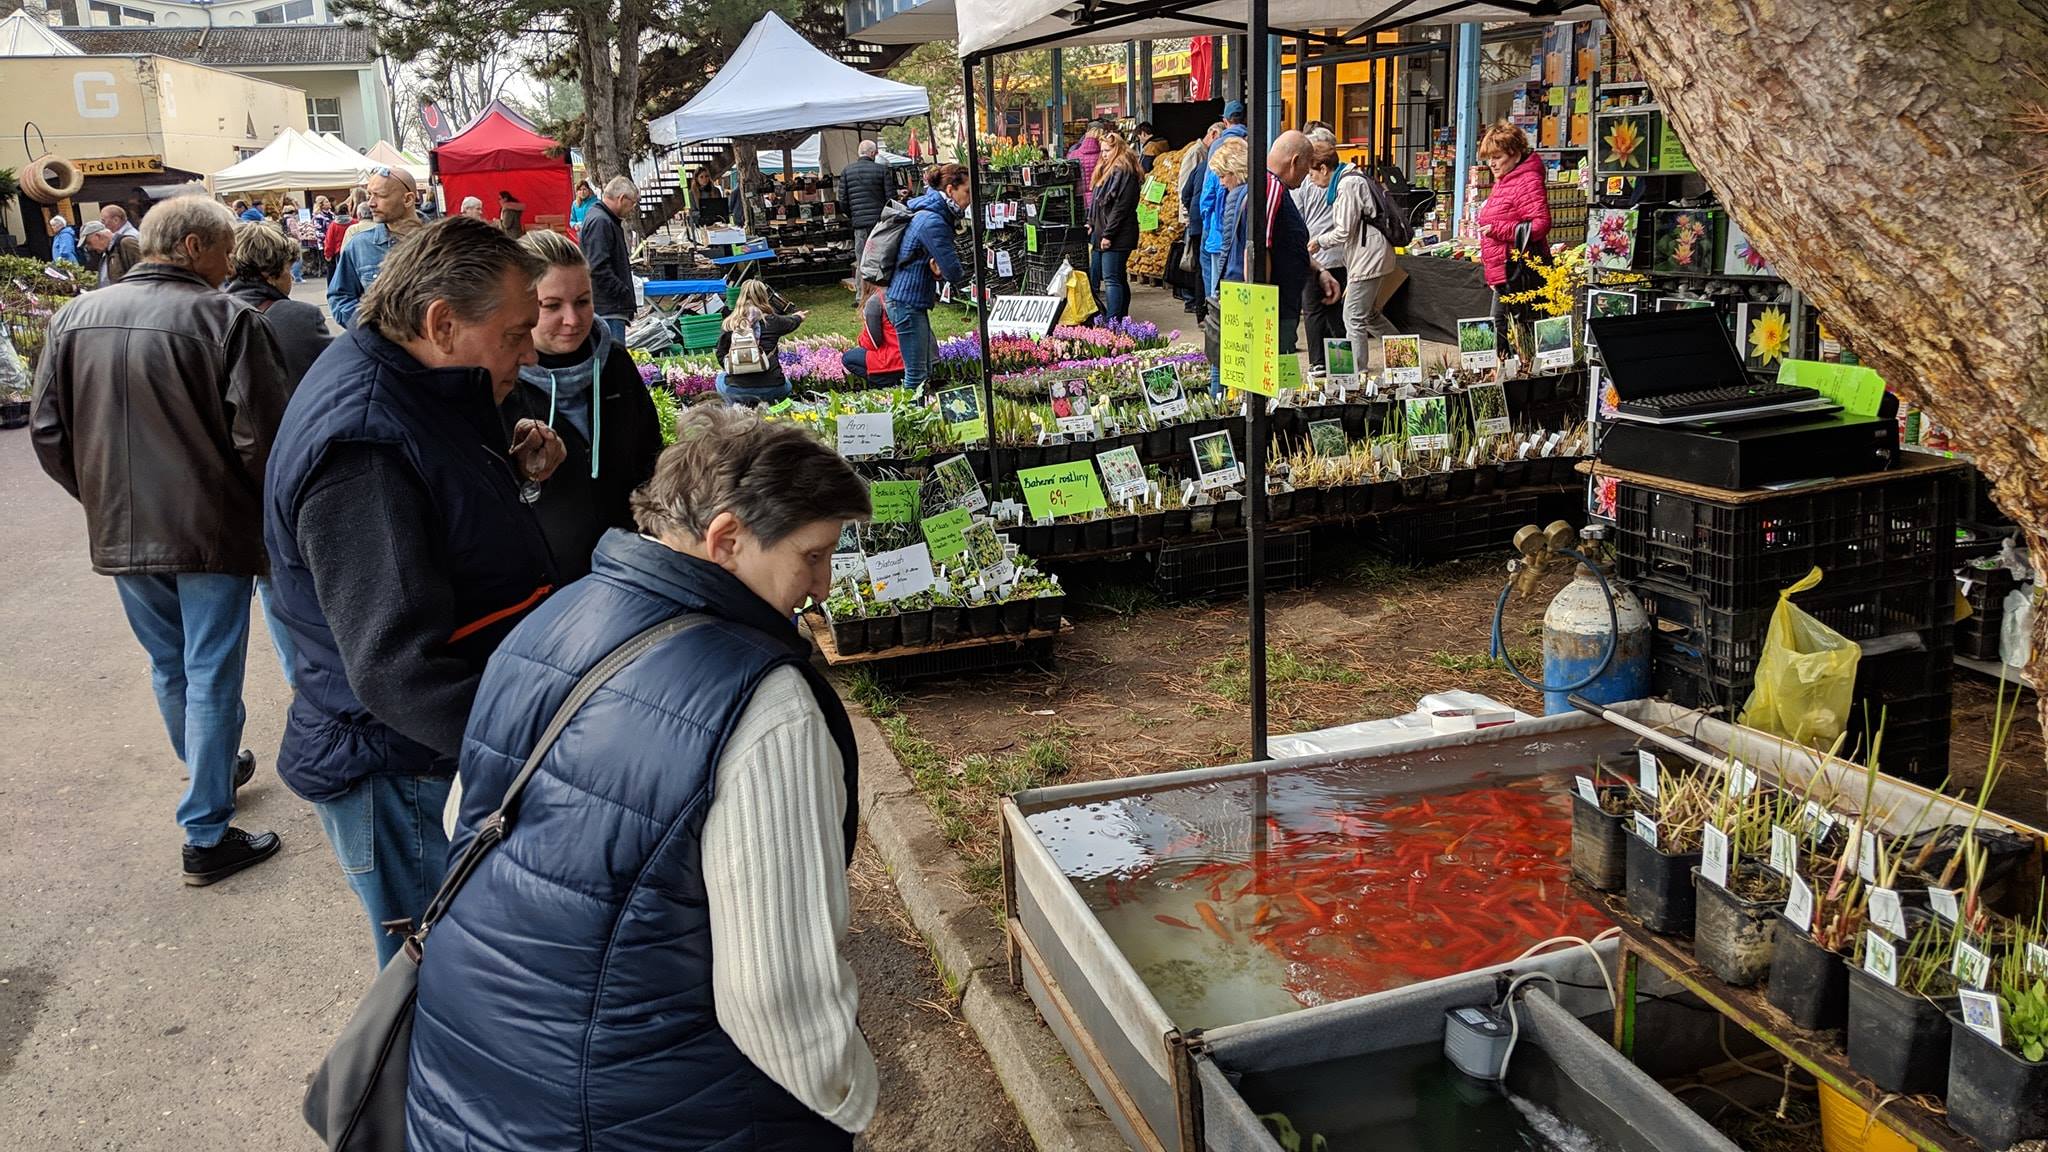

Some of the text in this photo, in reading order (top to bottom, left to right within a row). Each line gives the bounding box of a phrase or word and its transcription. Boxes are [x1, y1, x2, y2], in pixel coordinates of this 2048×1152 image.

[73, 72, 119, 118] G
[991, 299, 1055, 323] POKLADNA
[1049, 488, 1073, 507] 69,-
